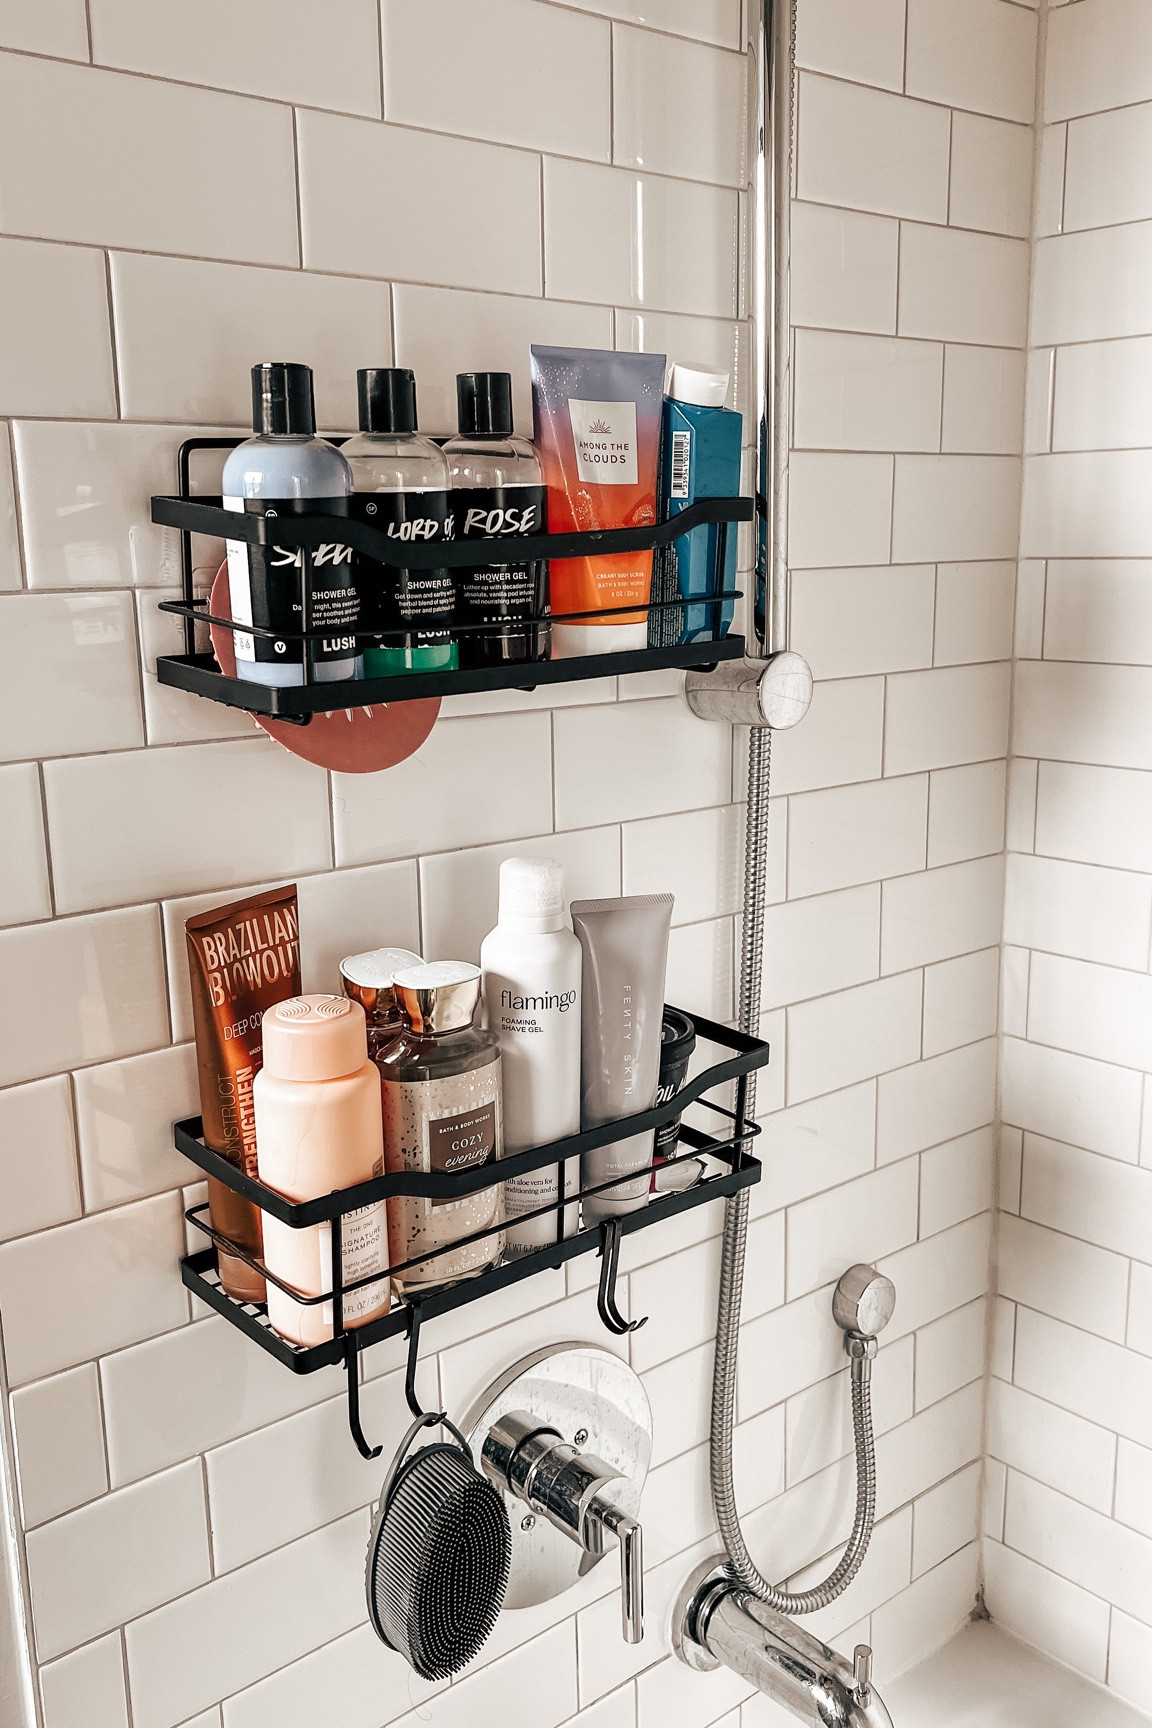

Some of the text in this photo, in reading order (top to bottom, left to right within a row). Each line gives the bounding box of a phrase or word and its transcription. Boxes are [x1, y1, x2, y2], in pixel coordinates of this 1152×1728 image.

[580, 441, 607, 450] AMONG
[583, 453, 626, 464] CLOUDS
[464, 505, 536, 534] ROSE
[387, 518, 439, 541] LORD
[474, 572, 528, 581] SHOWER GEL
[407, 578, 452, 590] SHOWER GEL
[312, 588, 356, 600] SHOWER GEL
[508, 590, 518, 598] pod
[314, 602, 332, 611] night,
[312, 620, 326, 628] your
[322, 636, 356, 652] LUSH
[202, 905, 300, 971] BRAZILIAN
[208, 940, 300, 1008] BLOWOUT
[500, 990, 576, 1012] flamingo
[502, 1016, 536, 1026] FOAMING
[502, 1024, 526, 1032] SHAVE
[223, 1018, 248, 1041] DEEP
[623, 985, 632, 1095] FENTY SKIN
[438, 1126, 454, 1134] BATH
[460, 1120, 474, 1129] BODY
[475, 1114, 490, 1124] WORKS
[452, 1132, 484, 1151] COZY
[445, 1146, 490, 1166] evening
[504, 1186, 540, 1195] onditioning
[350, 1220, 374, 1234] THE ONE
[342, 1225, 381, 1248] IGNATURE
[342, 1234, 380, 1256] SHAMPOO
[512, 1244, 522, 1252] WT
[524, 1244, 532, 1253] 6.7
[348, 1306, 355, 1314] FL
